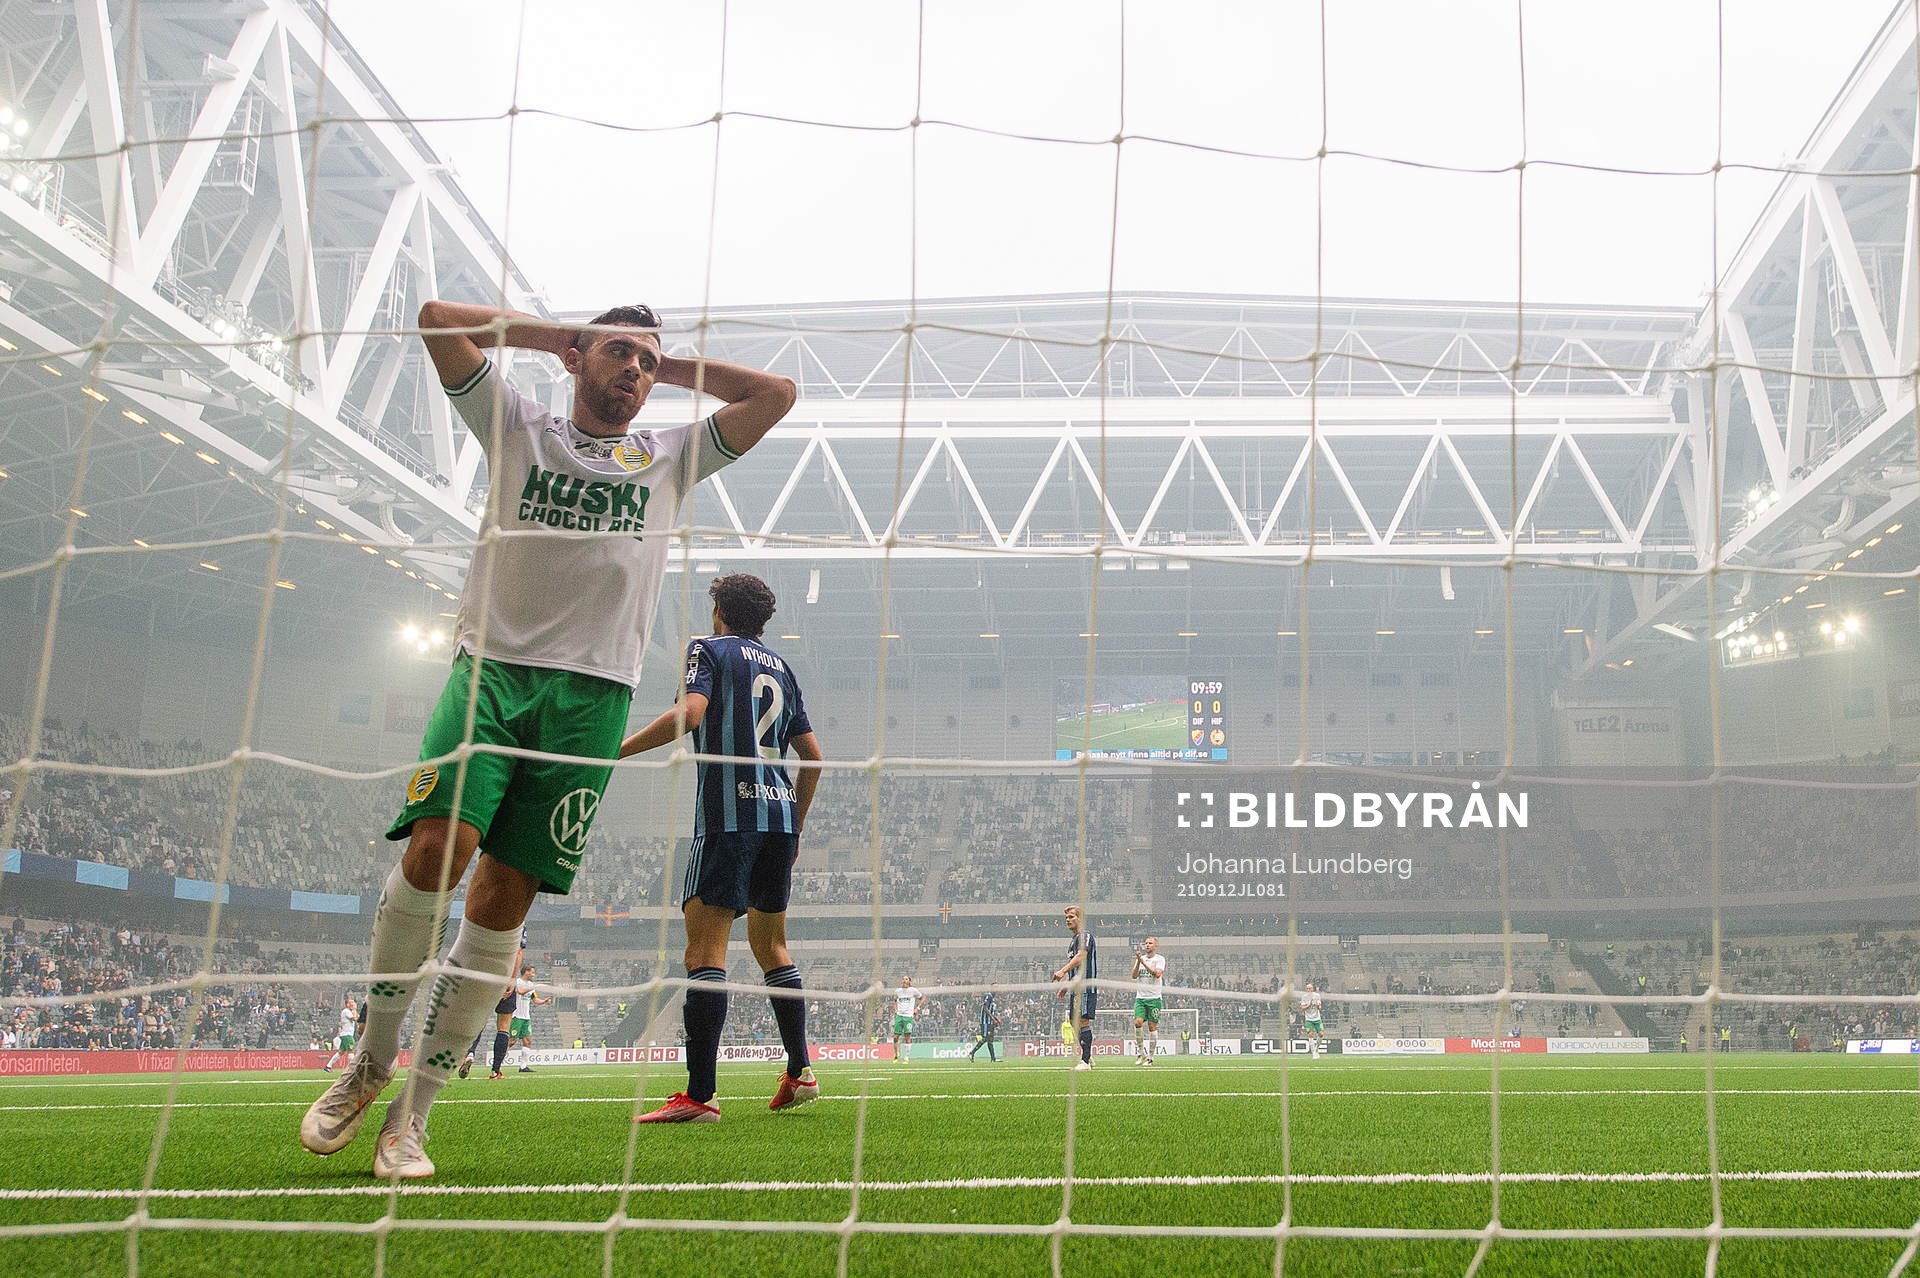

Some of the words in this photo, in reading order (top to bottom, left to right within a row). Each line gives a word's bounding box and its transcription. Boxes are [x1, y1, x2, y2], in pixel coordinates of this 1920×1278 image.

[741, 646, 784, 673] NYHOLM
[1191, 682, 1223, 694] 09:59
[1194, 700, 1202, 713] 0
[1212, 700, 1221, 713] 0
[751, 673, 784, 761] 2
[1192, 717, 1204, 725] DIF
[1184, 750, 1208, 759] dif.se
[1471, 1038, 1521, 1049] Moderna
[544, 1054, 550, 1062] &
[553, 1053, 574, 1062] PLÅT
[576, 1053, 588, 1062] AB
[607, 1049, 677, 1061] CRAMO
[818, 1046, 880, 1060] Scandic
[137, 1052, 148, 1070] Vi
[151, 1052, 175, 1071] fixar
[234, 1053, 246, 1069] du
